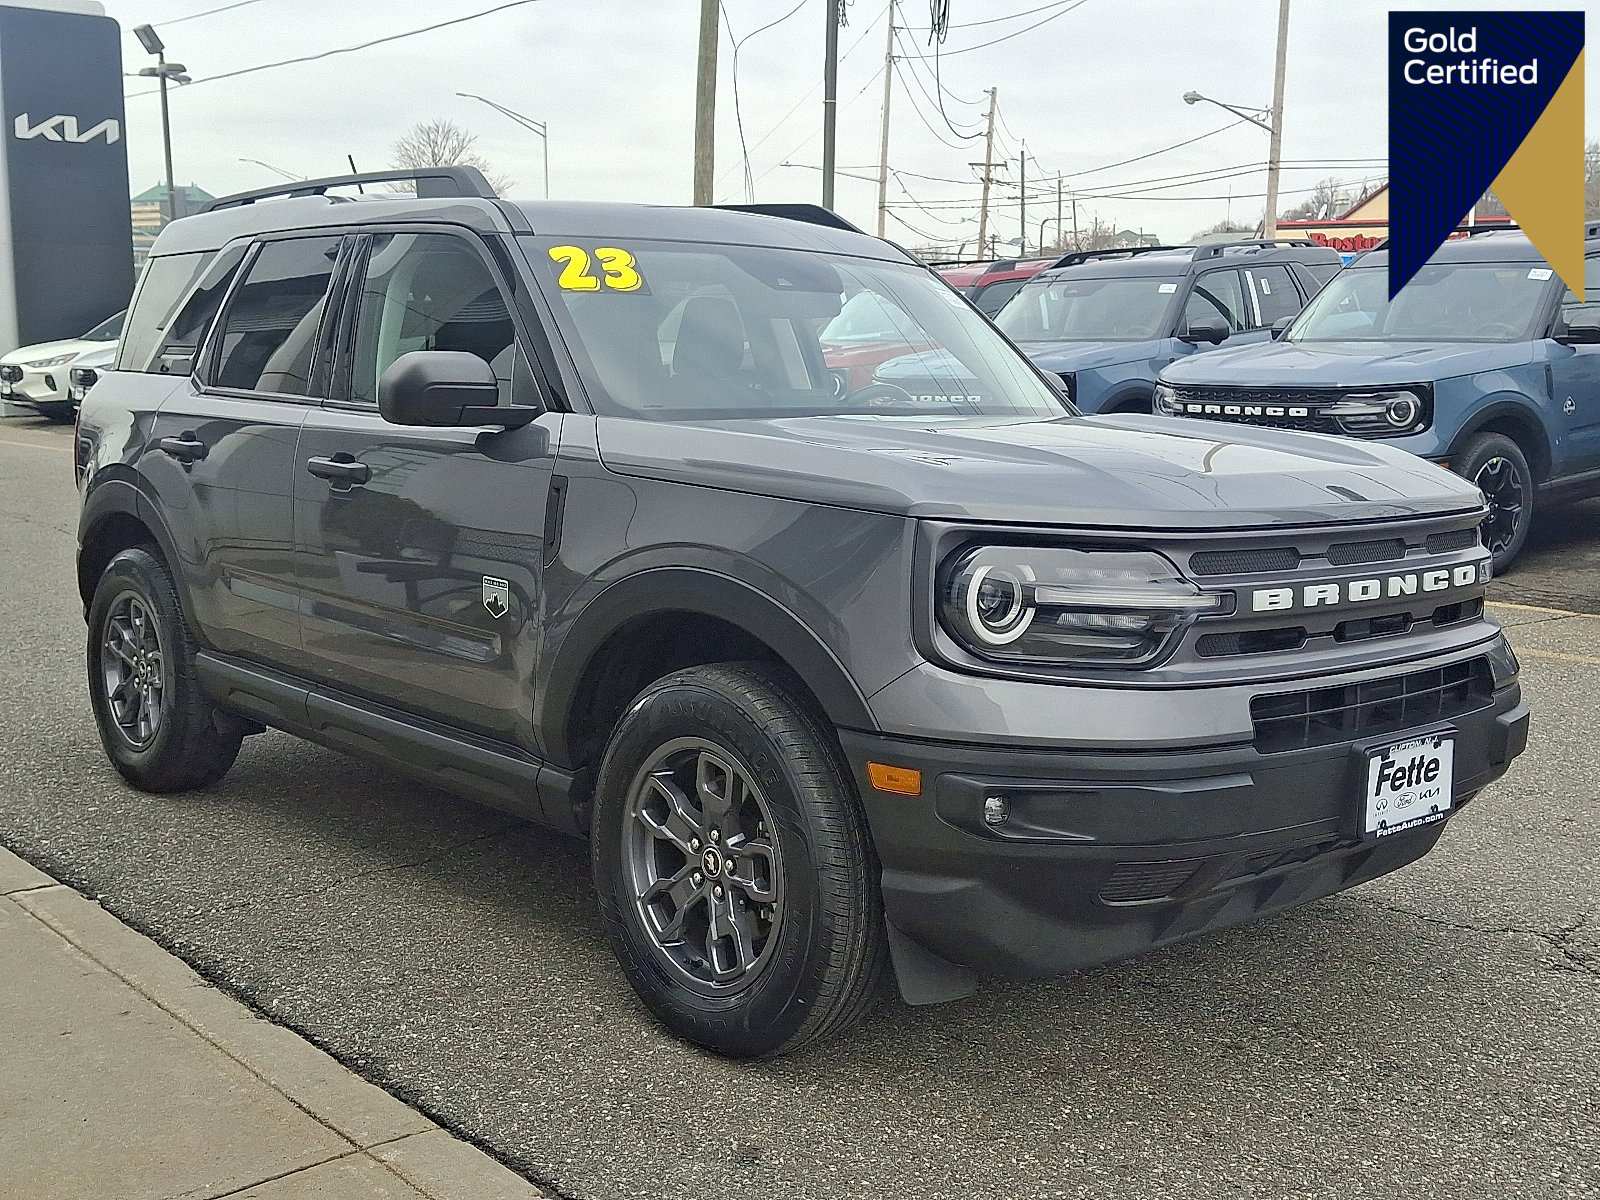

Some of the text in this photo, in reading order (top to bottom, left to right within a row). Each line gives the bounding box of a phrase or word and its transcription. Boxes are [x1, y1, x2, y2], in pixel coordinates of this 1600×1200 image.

[14, 112, 120, 145] KIA
[1310, 232, 1383, 251] Bosto
[547, 245, 643, 292] 23
[1187, 404, 1308, 417] BRONCO
[1252, 564, 1476, 612] BRONCO
[1375, 755, 1440, 797] Fette
[1376, 813, 1444, 837] FetteAuto.com
